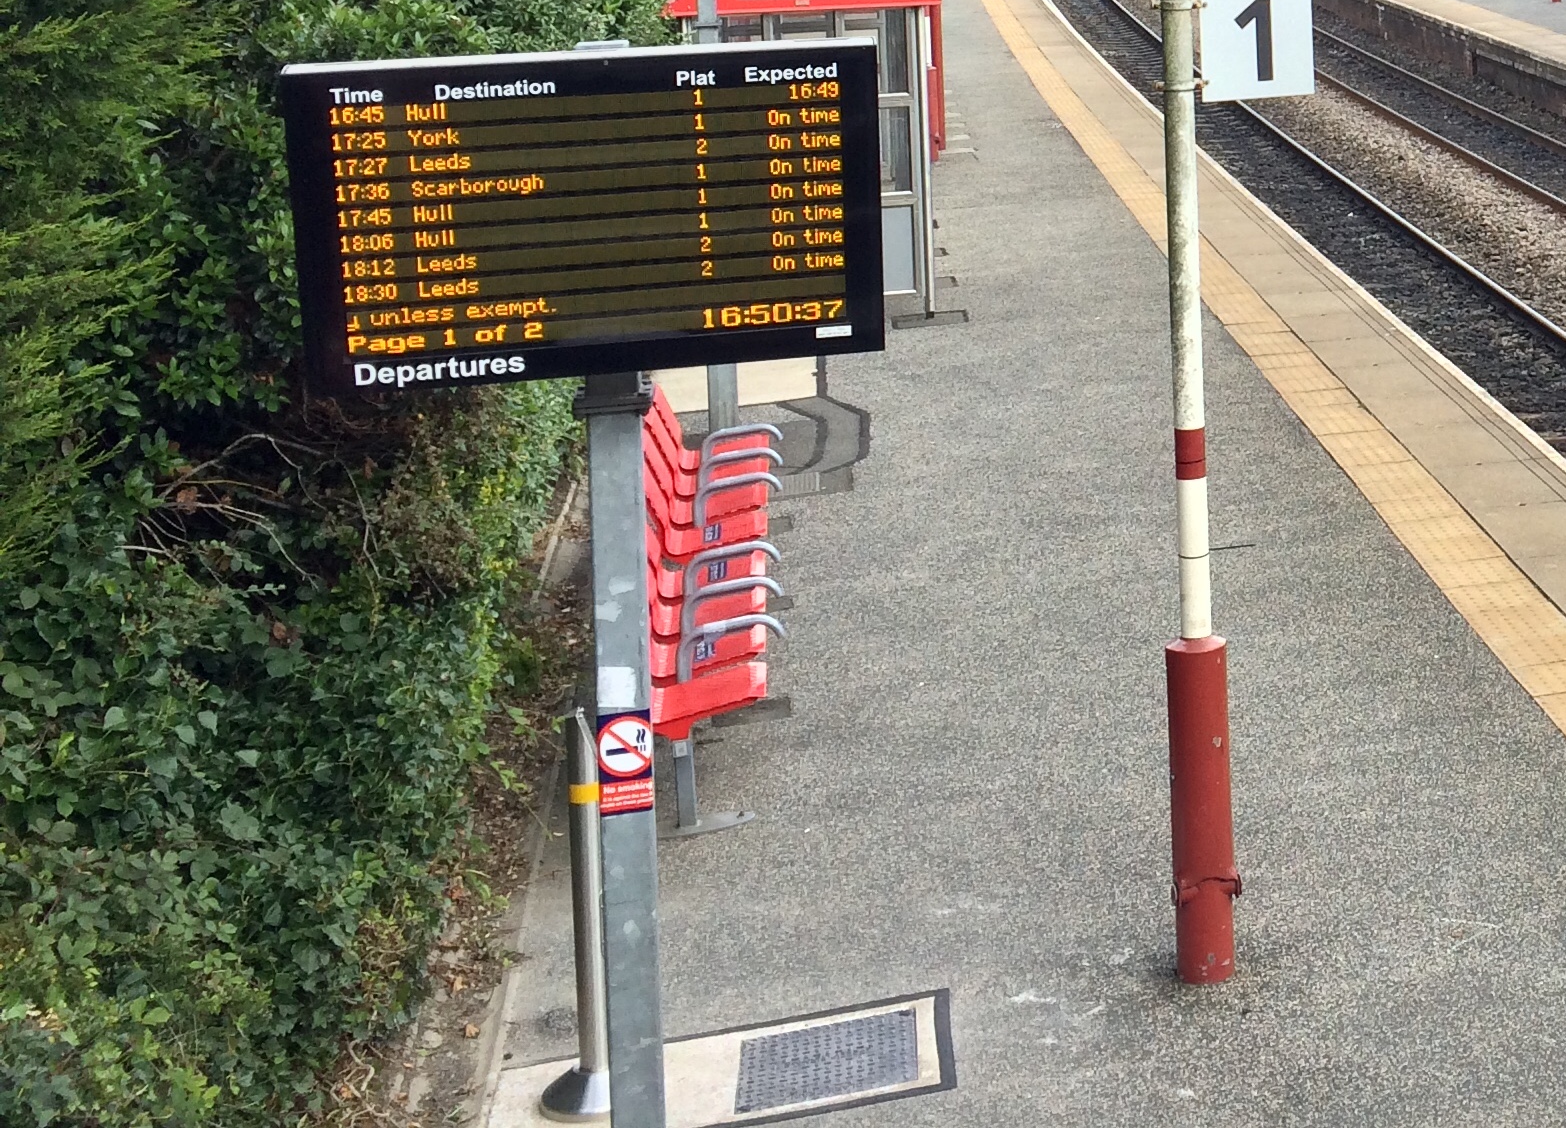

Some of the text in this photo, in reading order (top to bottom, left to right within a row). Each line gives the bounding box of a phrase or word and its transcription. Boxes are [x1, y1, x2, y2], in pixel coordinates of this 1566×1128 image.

[329, 62, 838, 104] Time Destination Plat Expected
[329, 81, 839, 125] 16:45 Hull 1 16:49
[331, 107, 840, 151] 17:25 York 1 On time
[333, 131, 841, 177] 17:27 Leeds 2 On time
[335, 156, 841, 203] 17:36 Scarborough 1 On time
[337, 180, 842, 228] 17:45 Hull 1 On time
[340, 204, 843, 253] 18:06 Hull 1 On time
[341, 228, 843, 278] 18:12 Leeds 2 On time
[343, 252, 844, 304] 18:30 Leeds 2 On time
[347, 299, 843, 354] Page 1 of 2 16:50:37
[369, 307, 455, 326] unless
[466, 297, 557, 319] exempt.
[353, 355, 526, 388] Departures
[603, 781, 653, 795] No smoking
